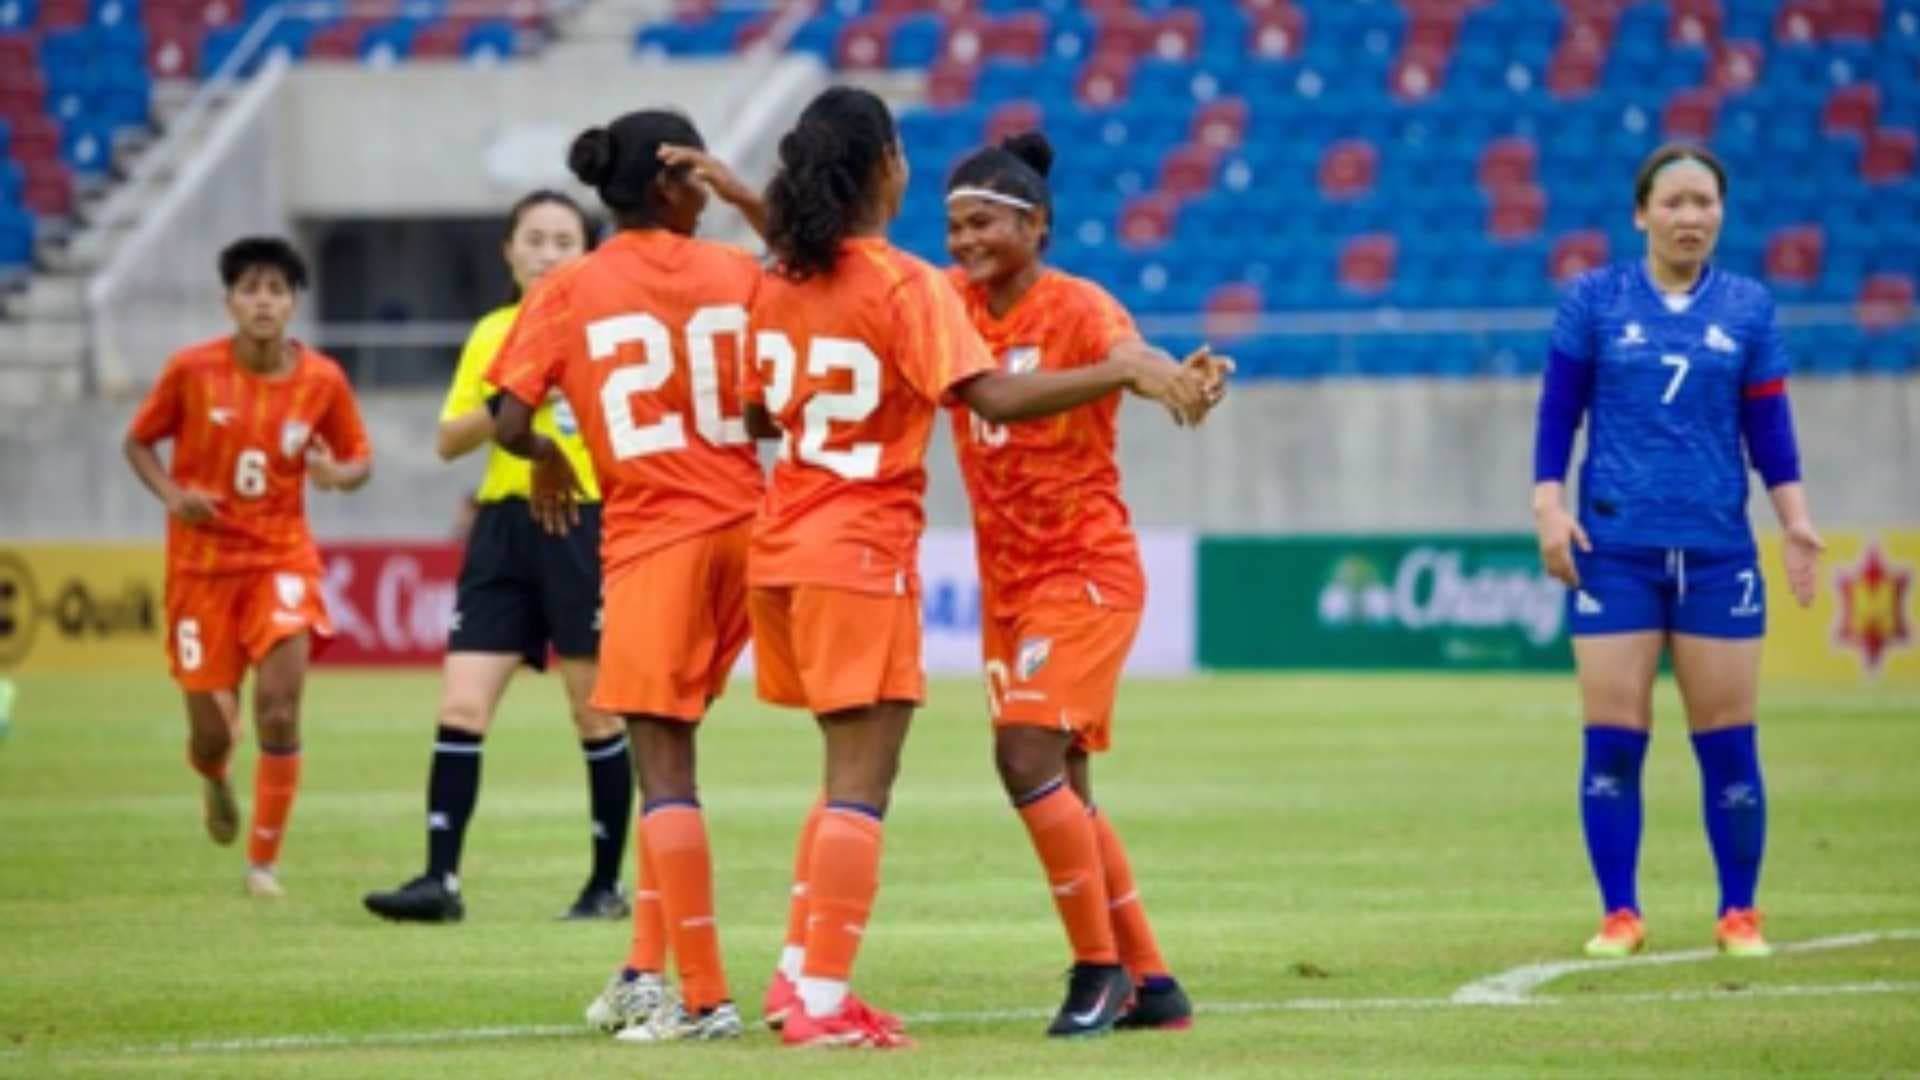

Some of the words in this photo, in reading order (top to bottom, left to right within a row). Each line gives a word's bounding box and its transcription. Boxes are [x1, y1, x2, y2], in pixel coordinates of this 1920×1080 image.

[586, 304, 750, 461] 20
[1660, 354, 1690, 404] 7
[234, 449, 268, 497] 6
[175, 617, 203, 671] 6
